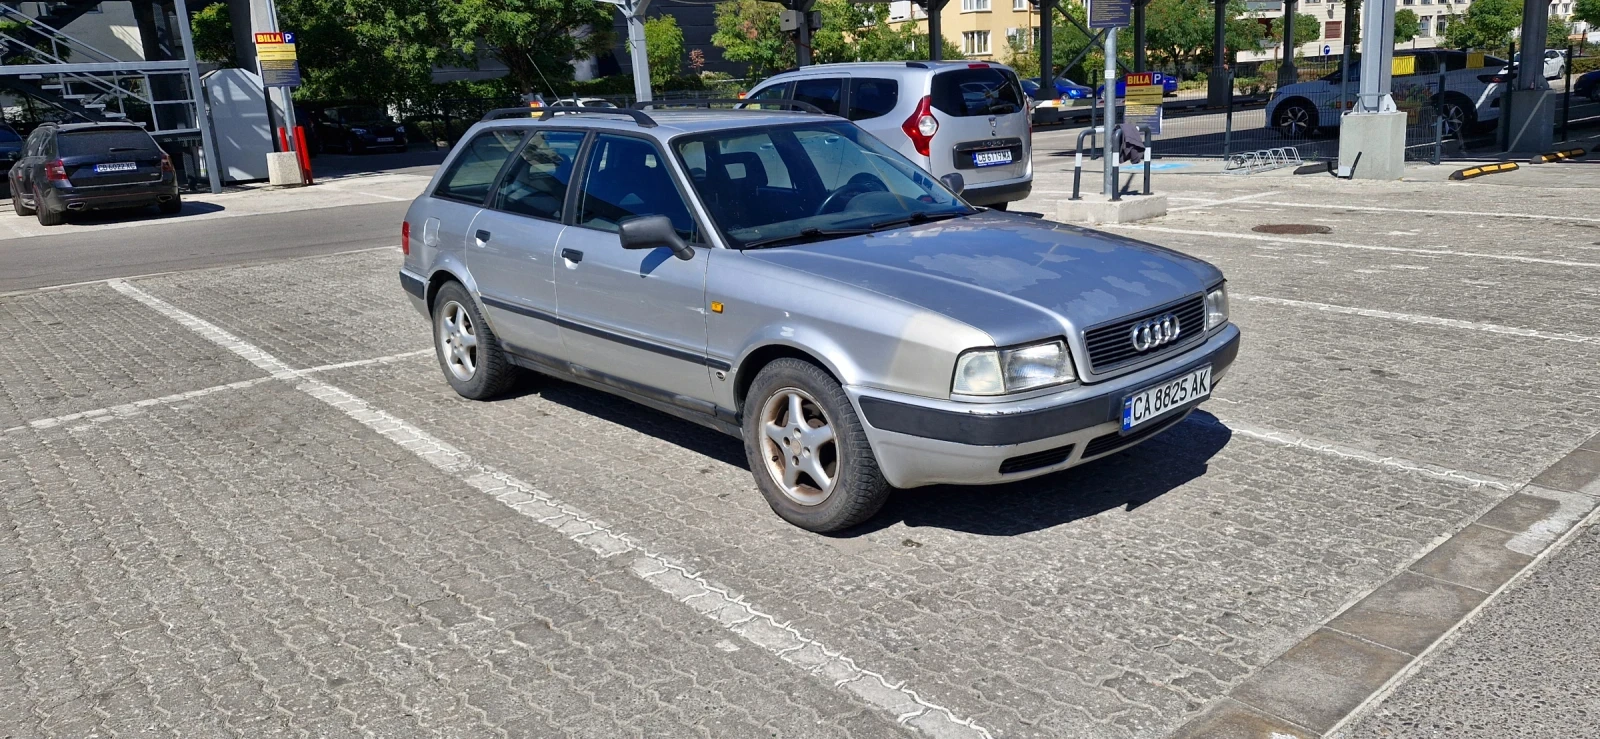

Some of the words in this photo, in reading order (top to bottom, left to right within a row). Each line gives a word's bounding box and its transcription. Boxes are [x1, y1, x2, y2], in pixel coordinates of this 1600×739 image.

[256, 34, 282, 43] BILLA
[284, 33, 292, 43] P
[1127, 75, 1150, 85] BILLA
[1154, 73, 1162, 84] P
[1133, 392, 1151, 421] CA
[1154, 378, 1188, 412] 8825
[1190, 369, 1208, 399] AK
